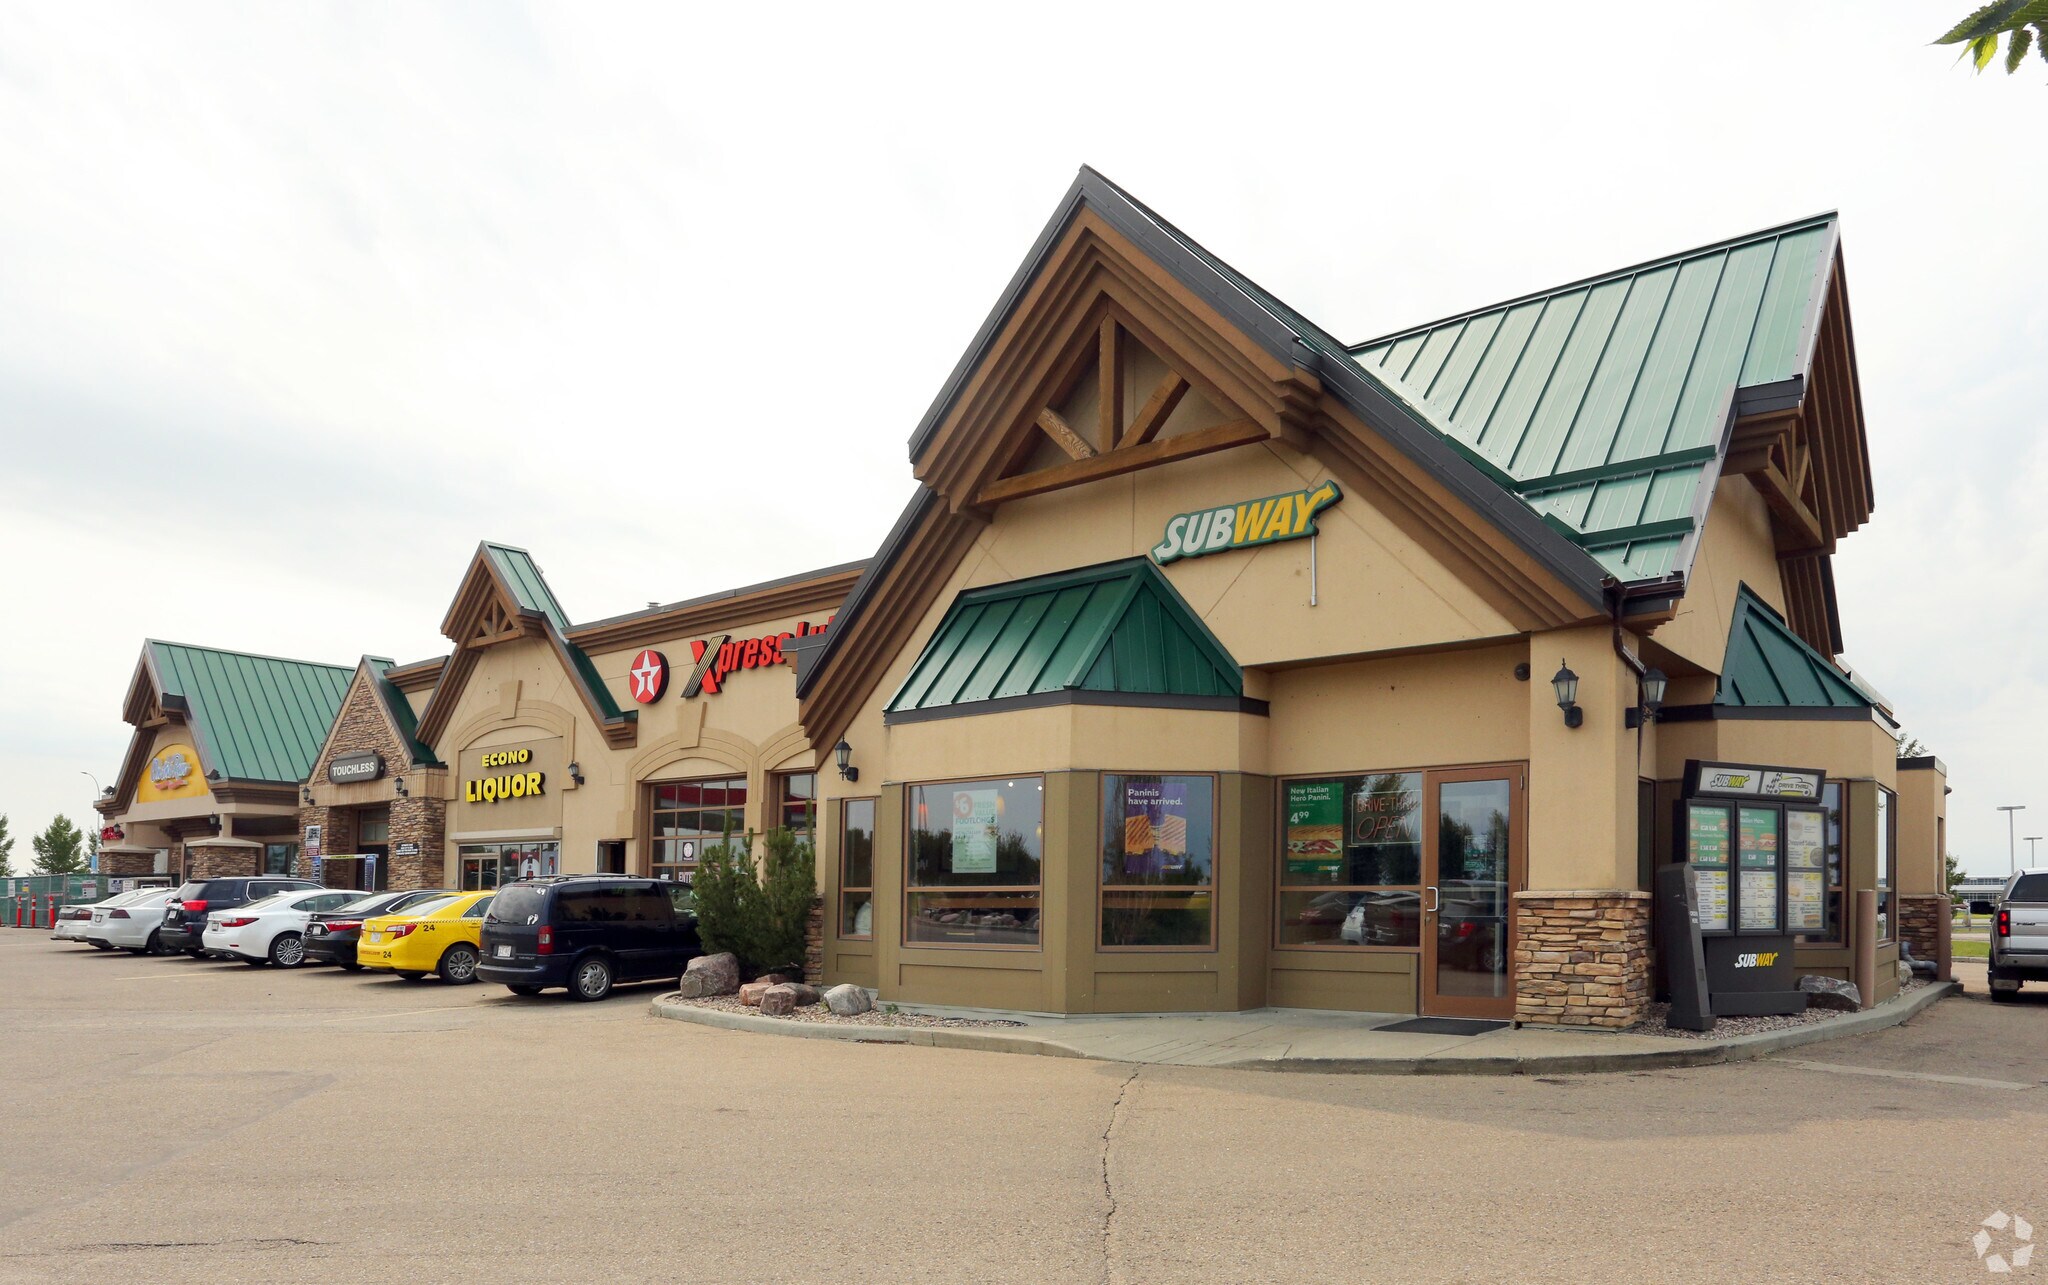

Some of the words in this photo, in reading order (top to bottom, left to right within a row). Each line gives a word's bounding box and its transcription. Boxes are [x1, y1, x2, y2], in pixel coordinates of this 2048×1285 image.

[1154, 484, 1335, 561] SUBWAY
[481, 748, 529, 768] ECONO
[332, 761, 375, 777] TOUCHLESS
[465, 771, 542, 803] LIQUOR
[1710, 773, 1750, 788] SUBWAY
[1128, 788, 1159, 797] Paninis
[1290, 787, 1306, 795] New
[1306, 786, 1329, 794] Italian
[1308, 793, 1331, 801] Panini.
[1128, 797, 1149, 805] have
[1150, 797, 1183, 806] arrived.
[1357, 815, 1416, 840] OPEN
[423, 924, 435, 932] 24
[1734, 952, 1778, 968] SUBWAY
